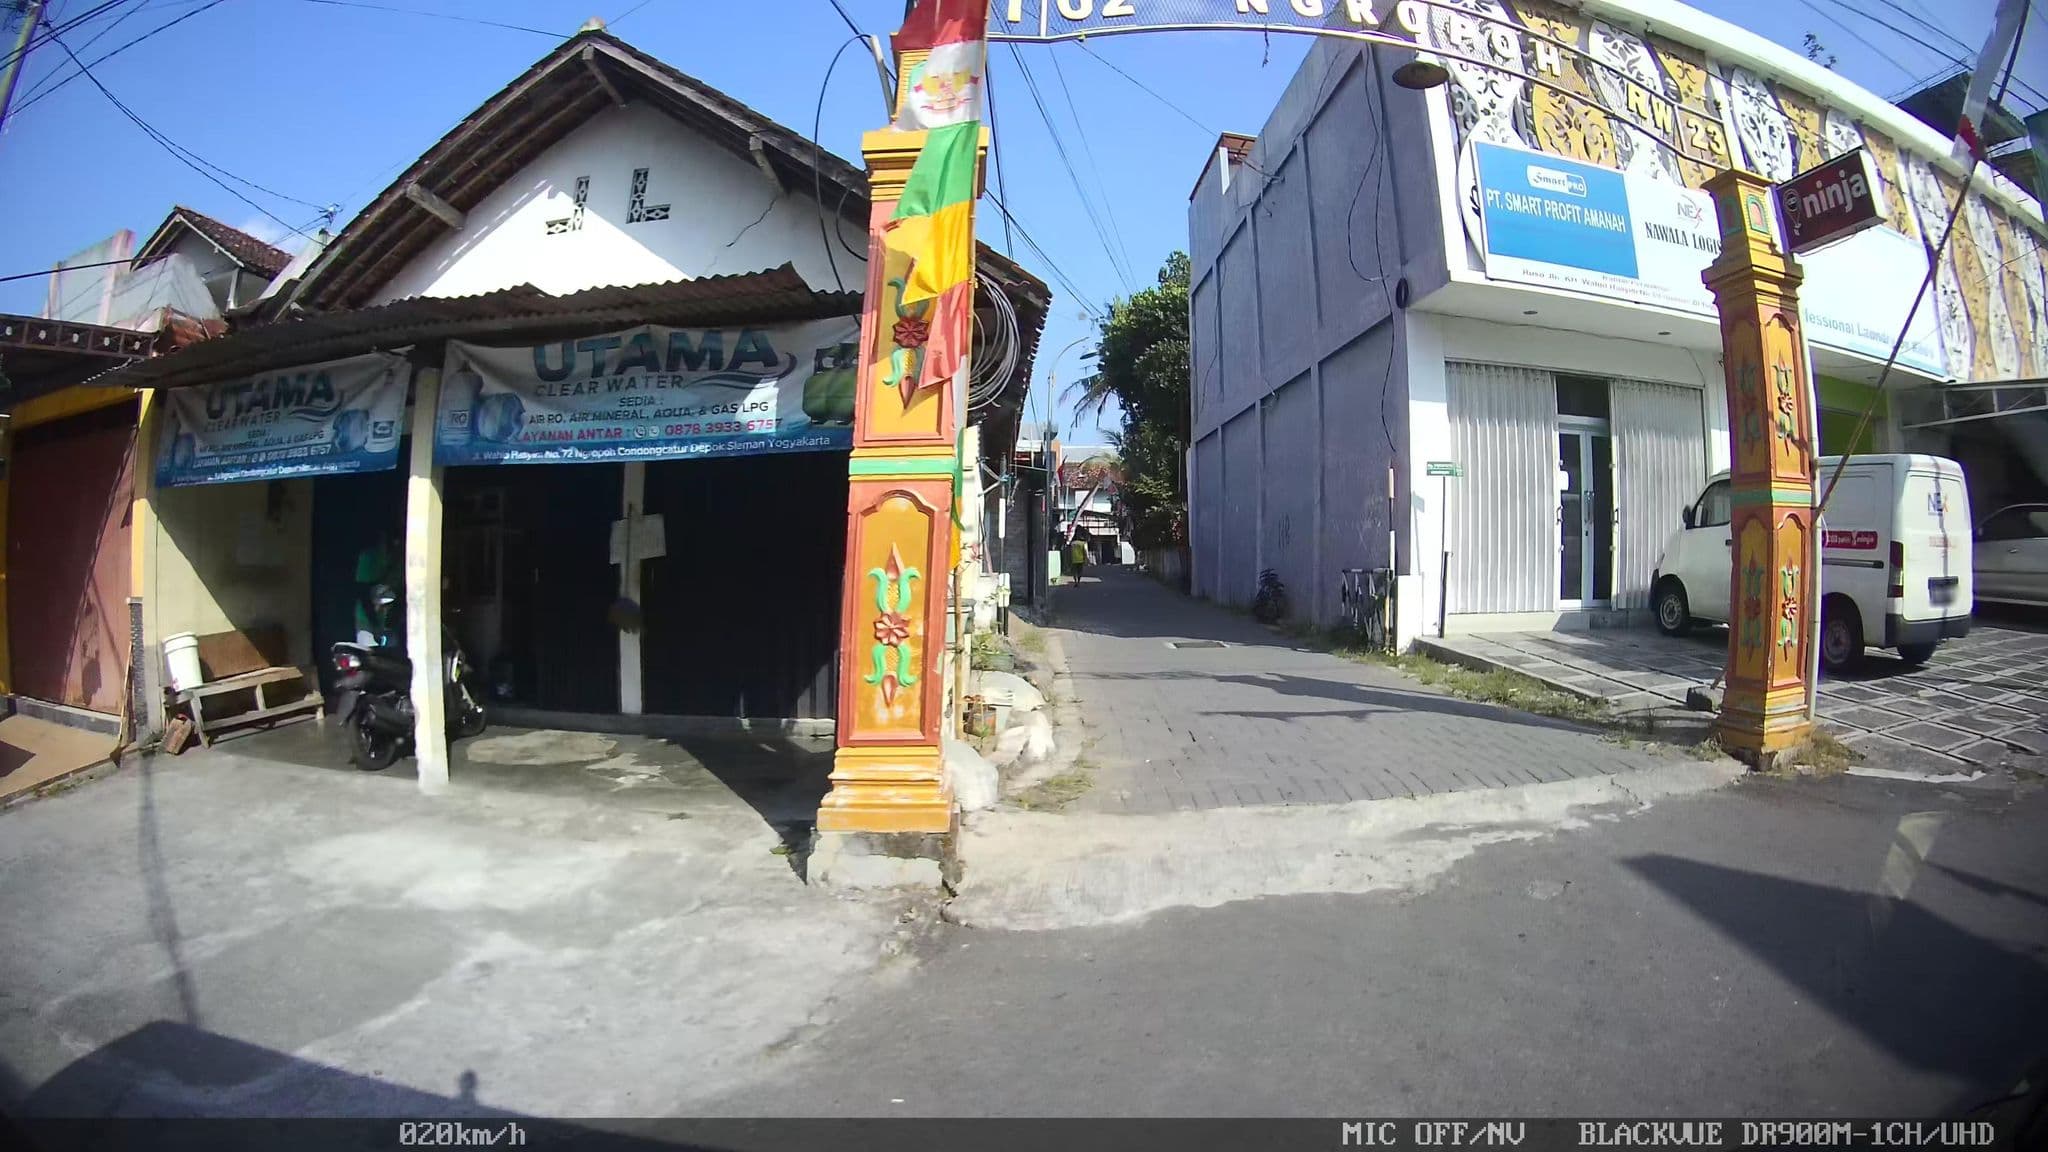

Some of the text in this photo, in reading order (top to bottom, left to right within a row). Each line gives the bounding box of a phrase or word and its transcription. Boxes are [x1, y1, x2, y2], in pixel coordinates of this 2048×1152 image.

[1626, 83, 1674, 135] RW
[1687, 118, 1726, 156] 23
[1532, 171, 1566, 187] Smart
[1802, 169, 1868, 219] ninja
[1505, 191, 1543, 217] SMART
[1544, 199, 1582, 225] PROFIT
[1583, 207, 1627, 234] AMANAH
[1644, 221, 1689, 248] NAWALA
[534, 326, 779, 384] UTAMA
[206, 370, 335, 418] UTAMA
[536, 374, 684, 398] CLEAR WATER
[711, 403, 739, 415] GAS
[741, 401, 770, 413] LPG
[577, 425, 623, 441] ANTAR
[745, 417, 783, 433] 6757
[766, 435, 831, 450] Yogyakarta
